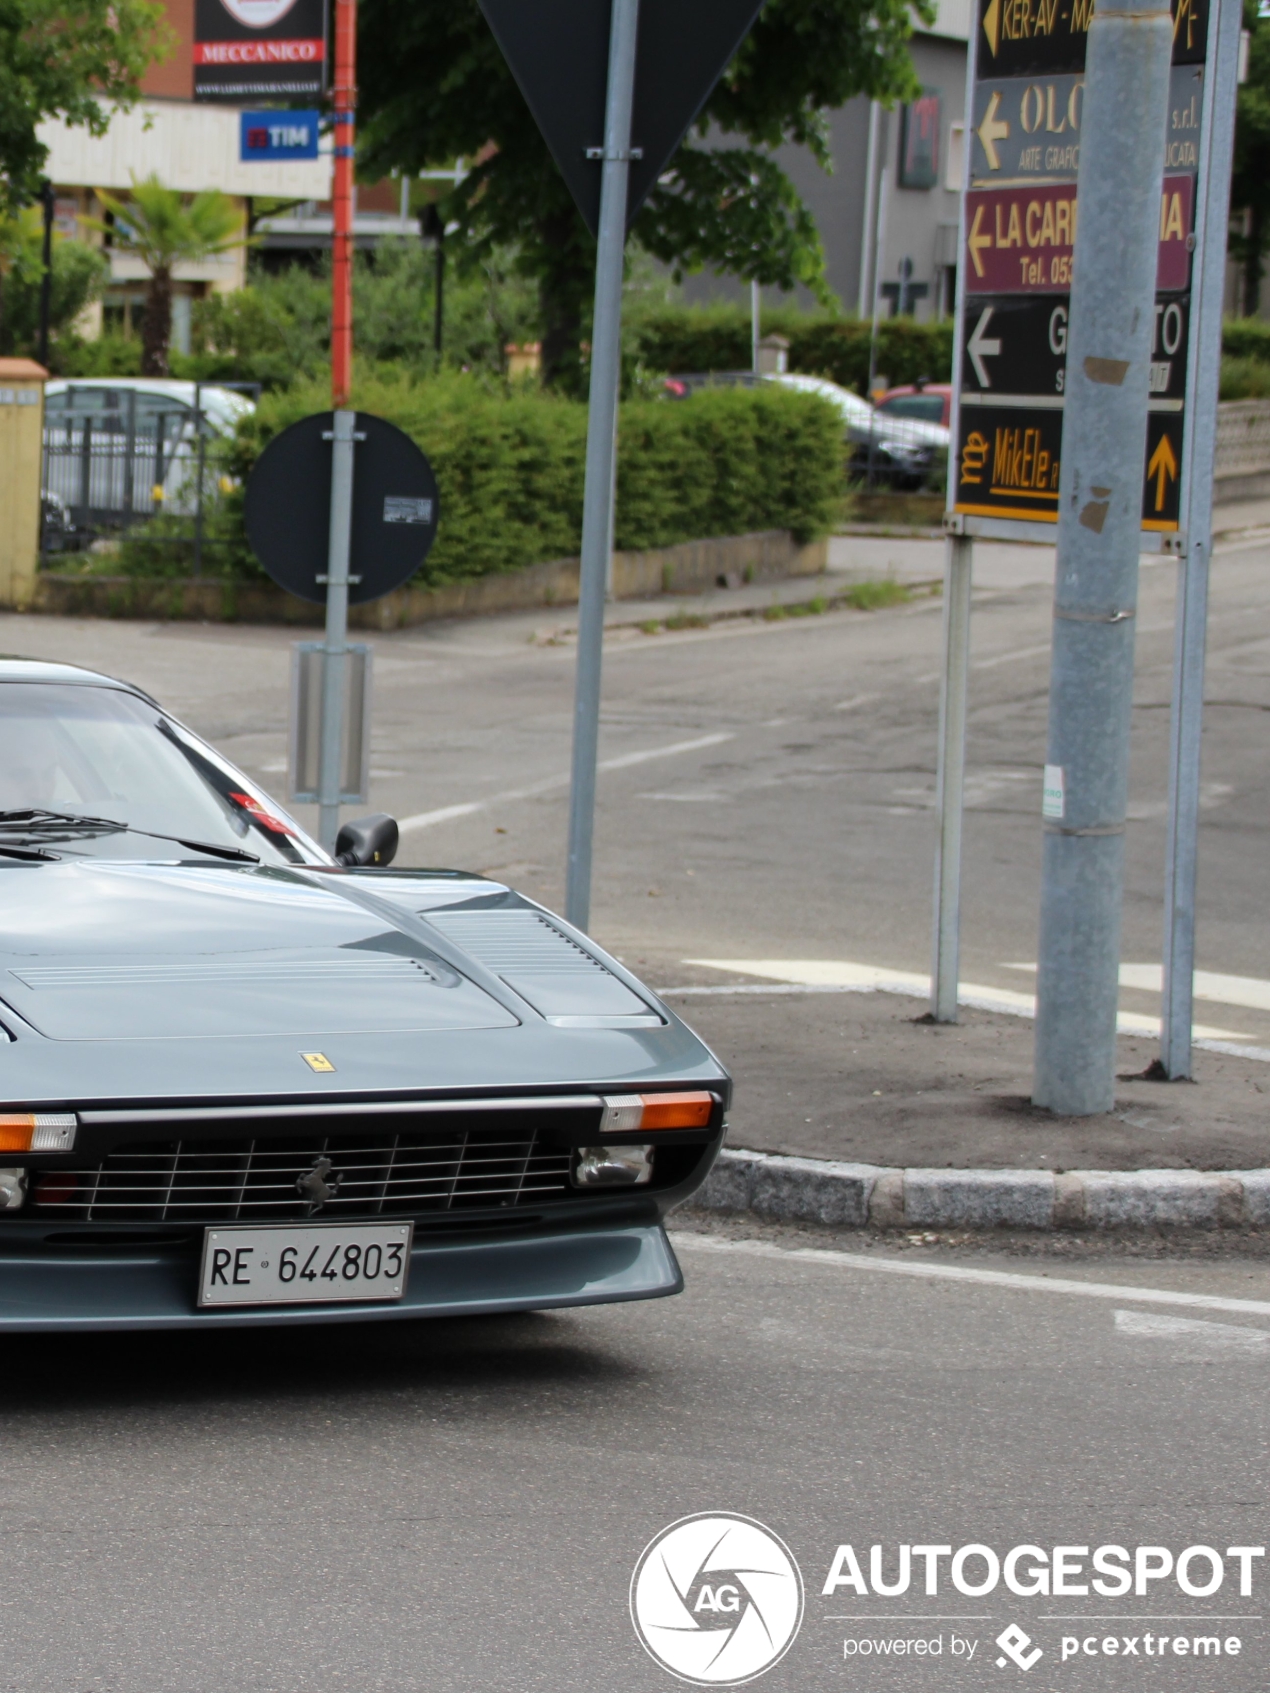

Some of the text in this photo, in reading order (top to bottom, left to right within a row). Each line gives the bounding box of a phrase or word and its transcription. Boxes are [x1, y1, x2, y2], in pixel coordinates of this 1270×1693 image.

[202, 41, 317, 62] MECCANICO
[268, 126, 309, 147] TIM
[1018, 145, 1041, 171] ARTE
[1045, 144, 1080, 170] GRAFIC
[995, 202, 1022, 248] LA
[1019, 256, 1045, 285] Tel.
[210, 1242, 405, 1285] RE 644803
